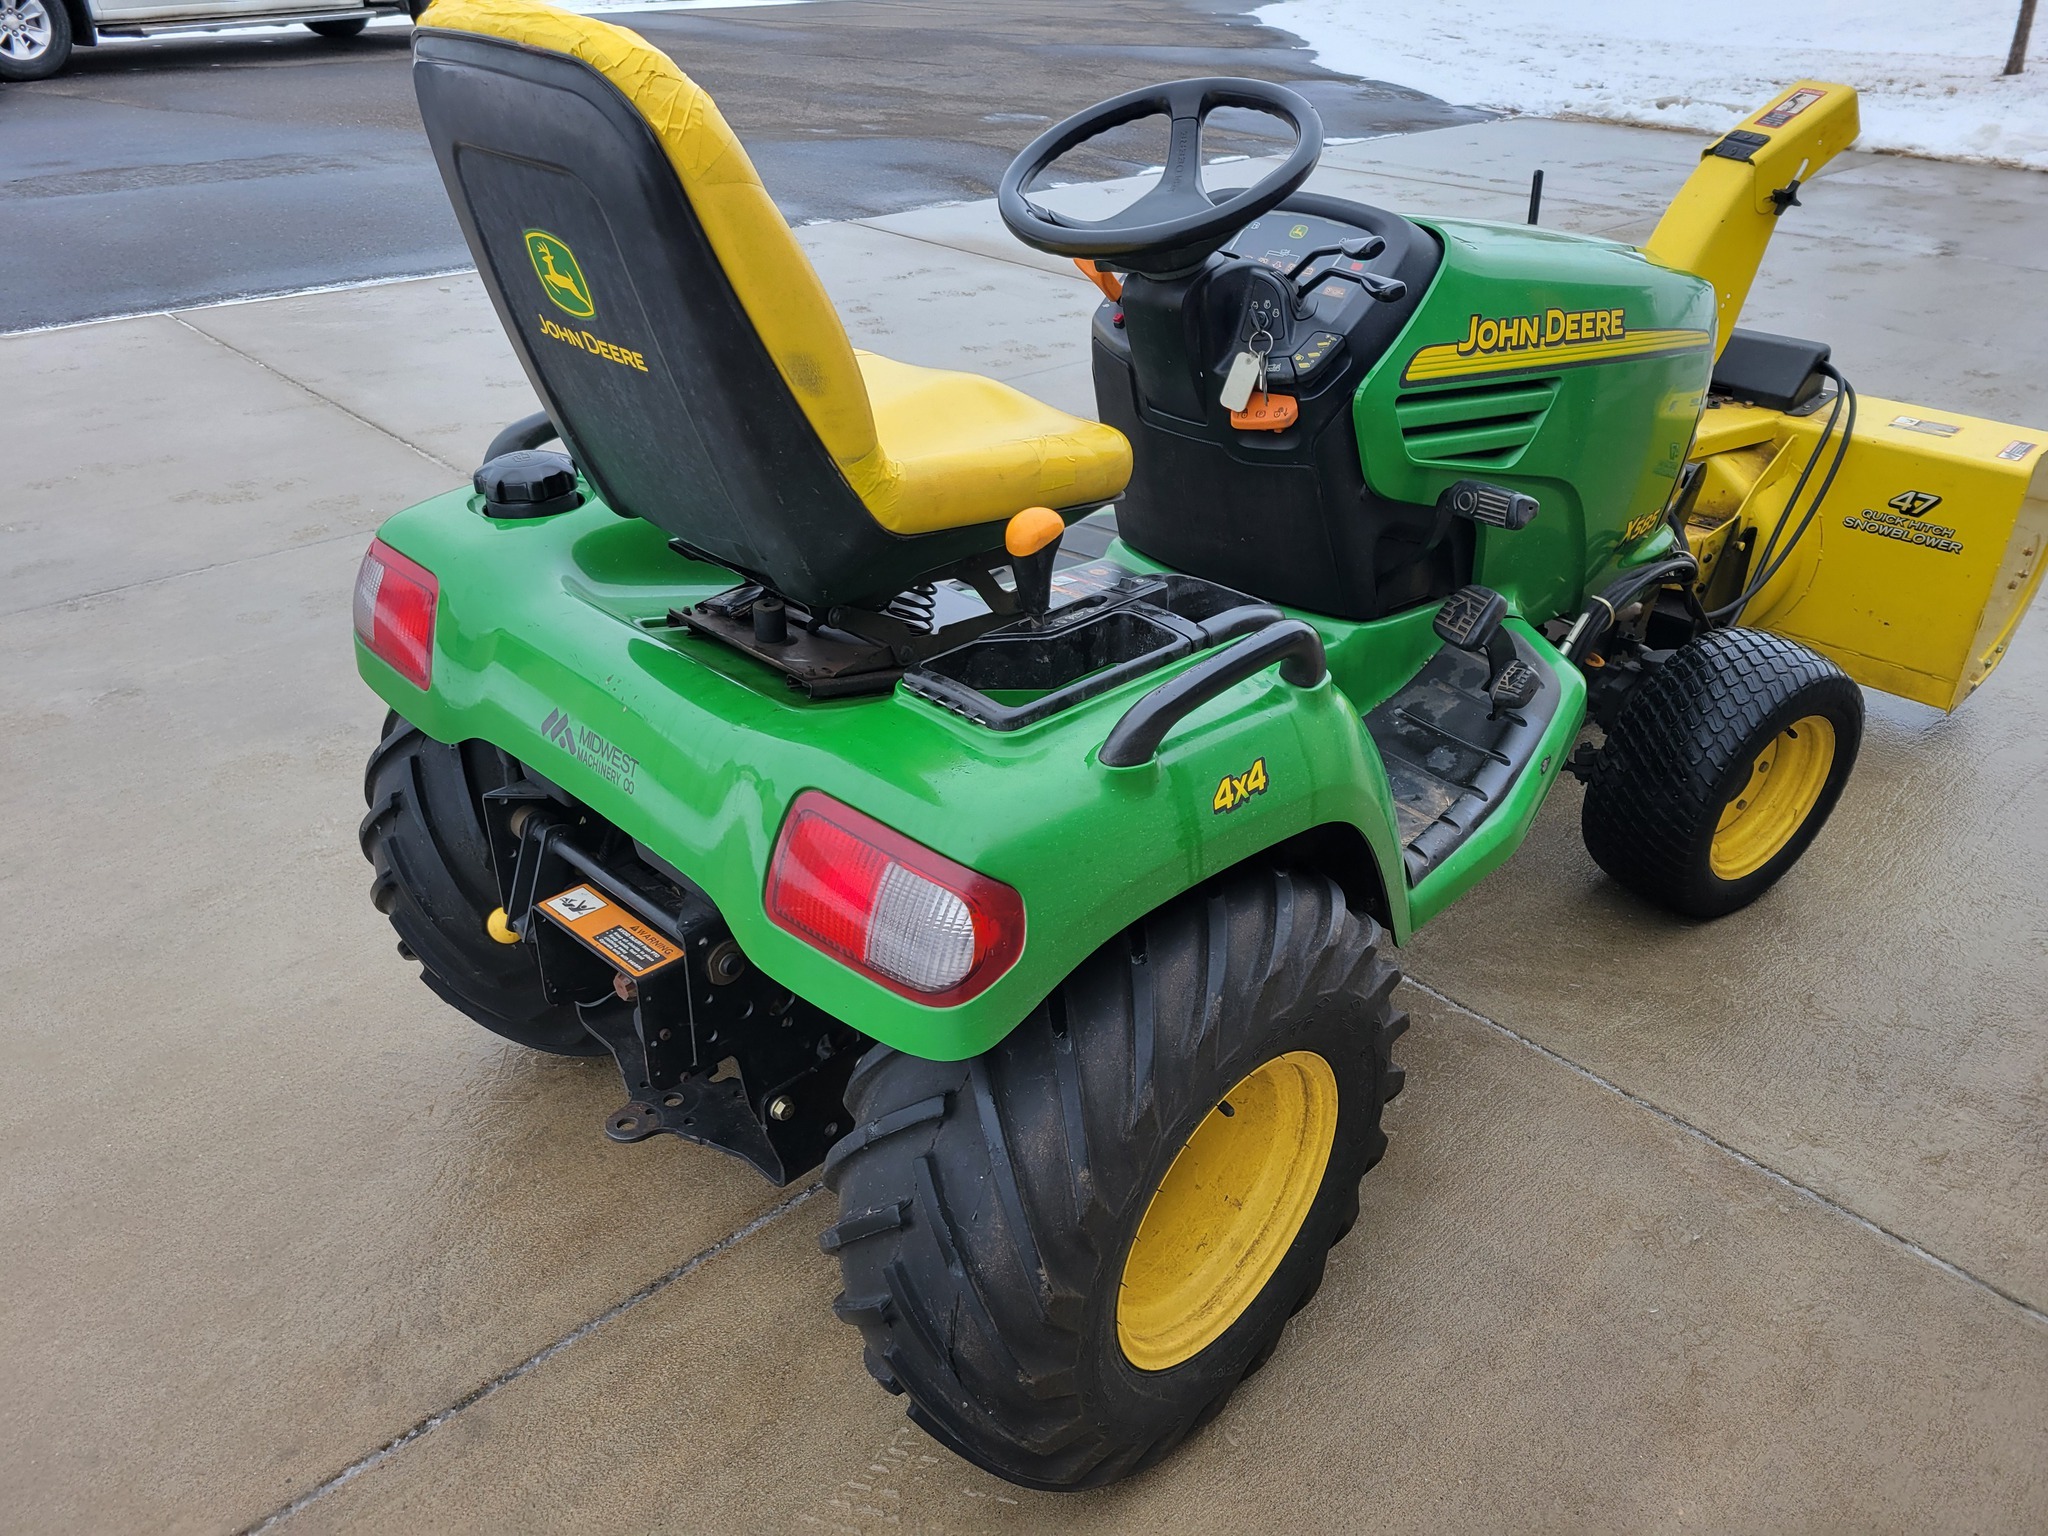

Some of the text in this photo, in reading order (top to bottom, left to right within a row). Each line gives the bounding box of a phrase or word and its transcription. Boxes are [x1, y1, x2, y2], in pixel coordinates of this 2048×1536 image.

[538, 314, 649, 372] JOHN DEERE
[1457, 308, 1626, 355] JOHN DEERE
[1862, 509, 1956, 538] QUICK HITCH
[1888, 490, 1943, 517] 47
[1843, 517, 1963, 554] SNOWBLOWER
[577, 747, 635, 795] MACHINERY CO
[579, 726, 640, 778] MIDWEST
[1213, 757, 1269, 814] 4x4
[637, 928, 674, 955] WARNING
